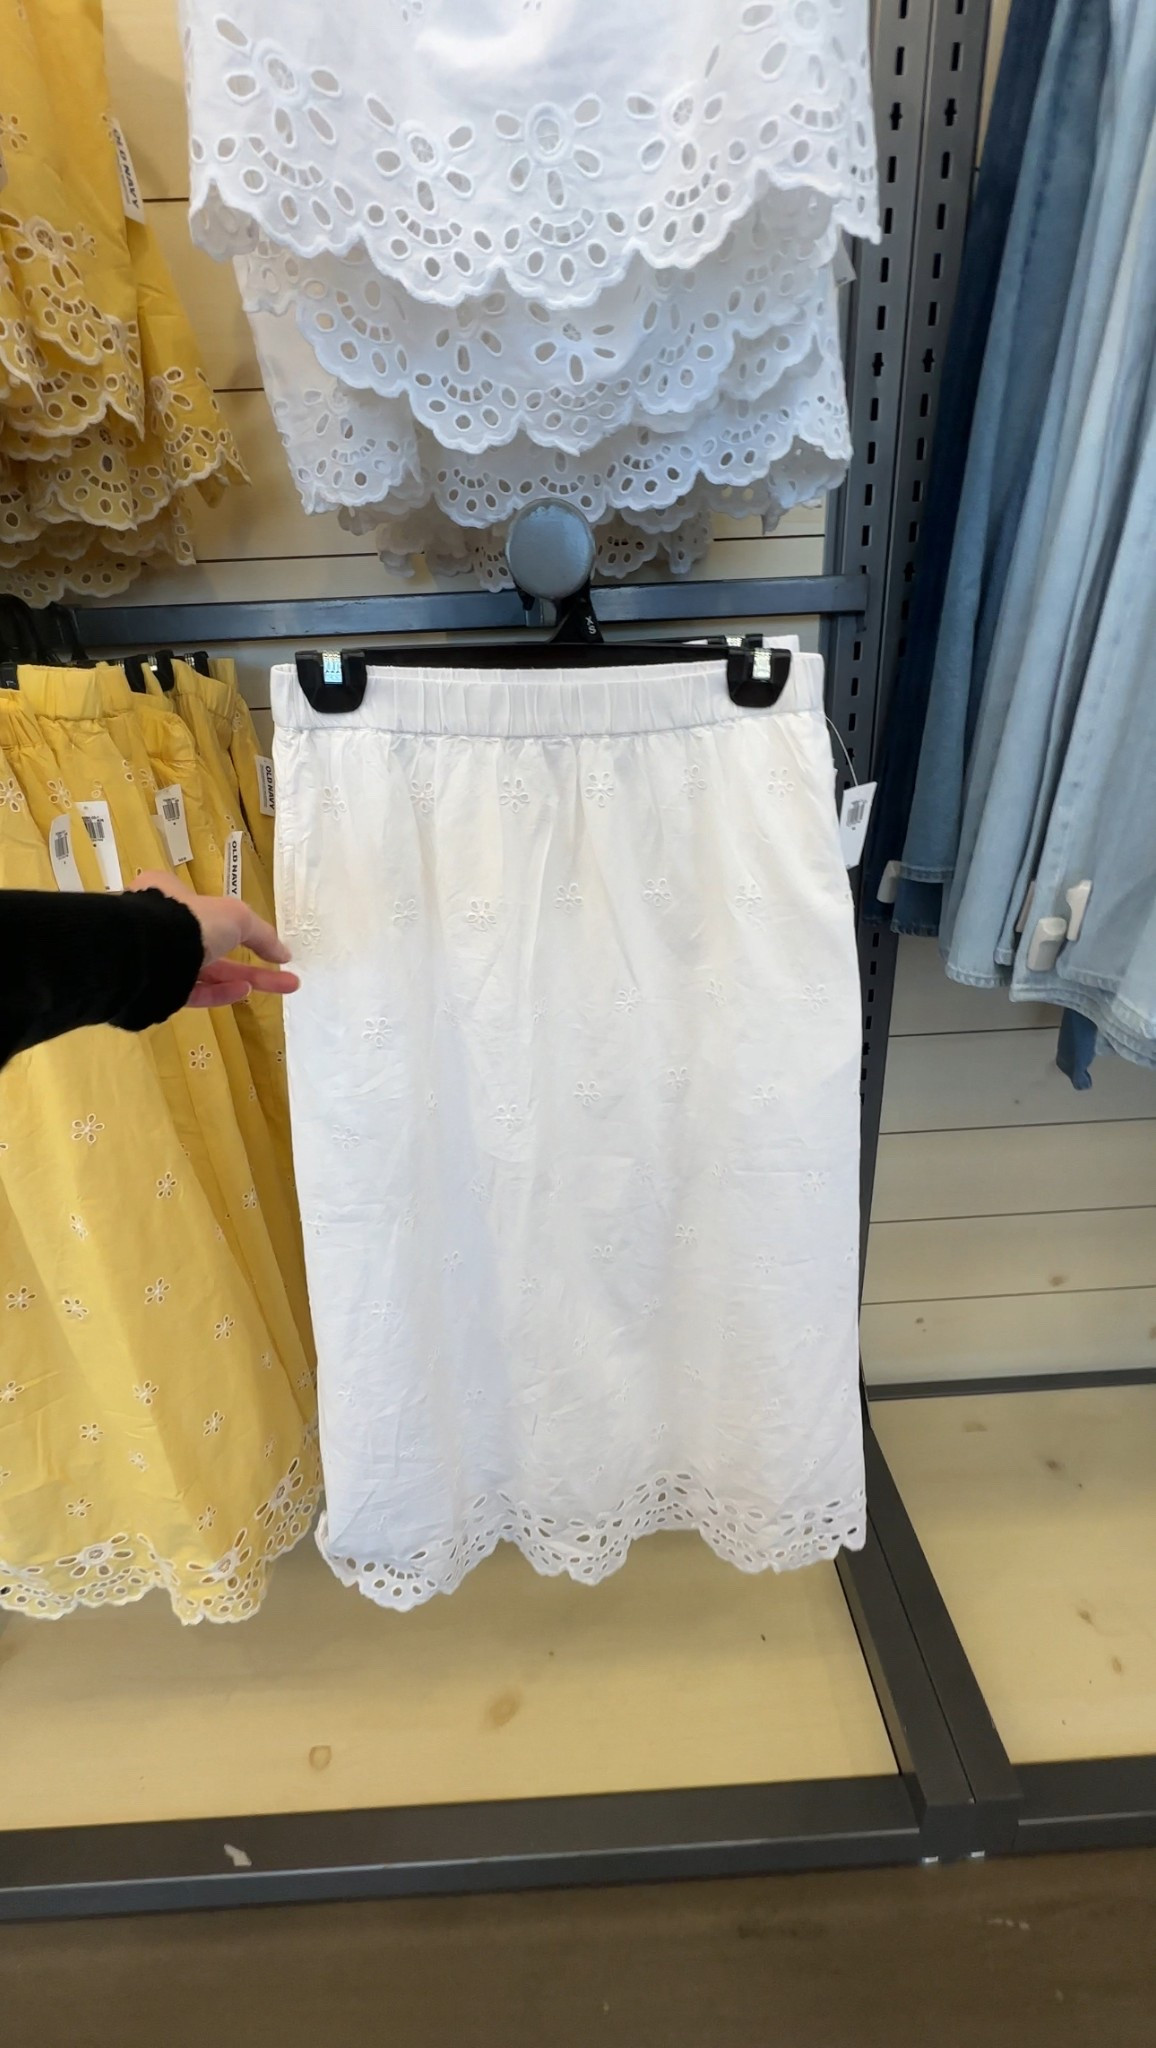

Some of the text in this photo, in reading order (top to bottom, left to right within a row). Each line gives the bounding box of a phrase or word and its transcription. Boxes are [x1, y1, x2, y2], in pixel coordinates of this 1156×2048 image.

[123, 163, 139, 209] NAVY
[585, 615, 597, 635] XS
[265, 765, 275, 810] OLD NAVY
